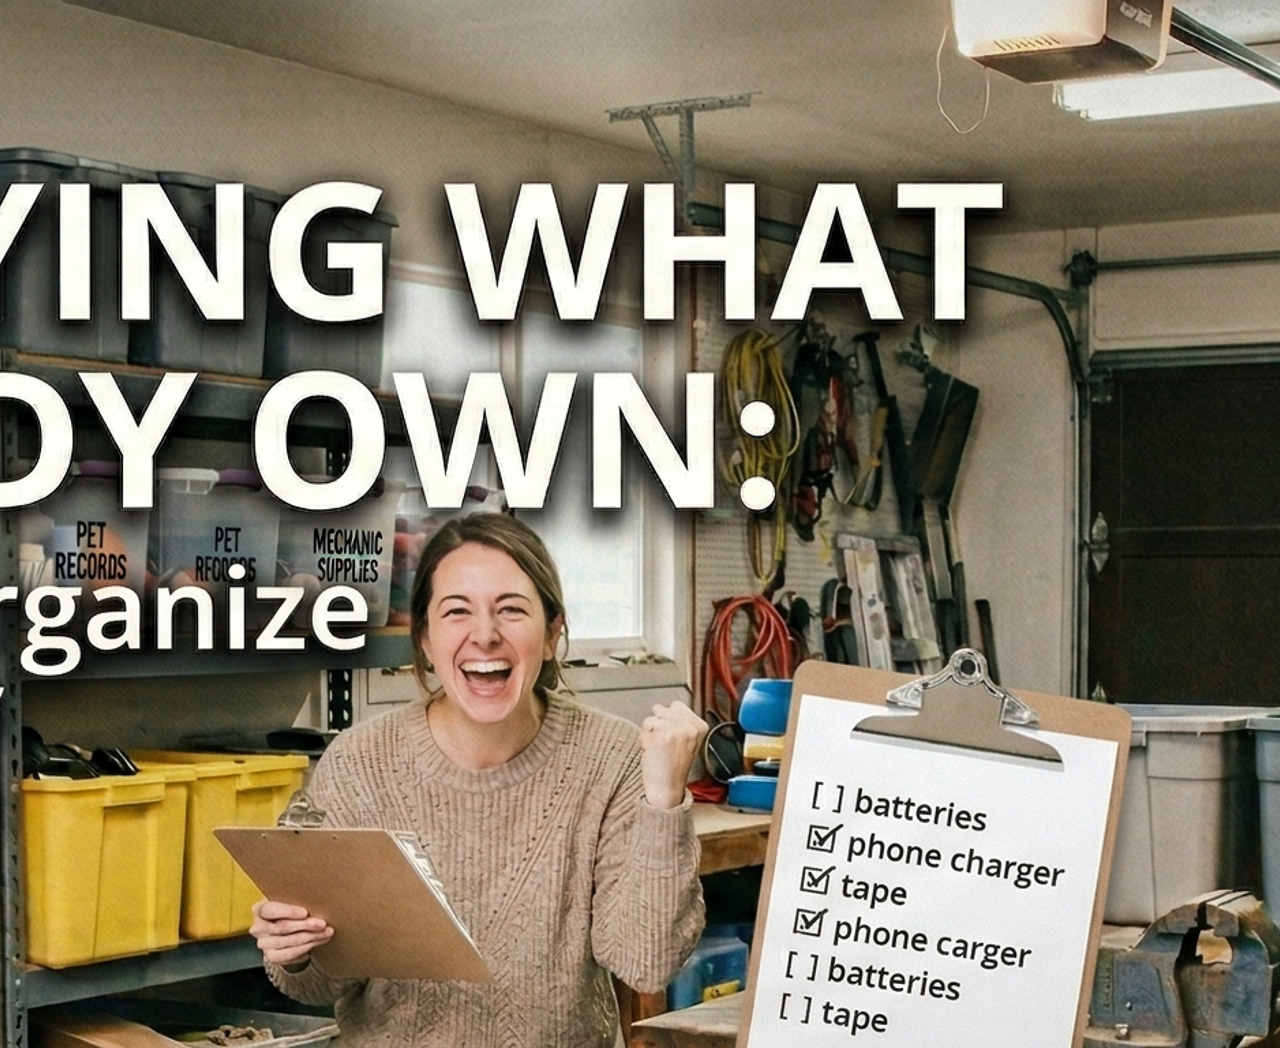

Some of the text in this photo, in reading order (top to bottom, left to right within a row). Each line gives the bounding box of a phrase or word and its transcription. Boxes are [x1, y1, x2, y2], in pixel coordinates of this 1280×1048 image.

[76, 520, 107, 548] PET
[215, 526, 241, 553] PET
[54, 551, 127, 581] RECORDS
[854, 788, 987, 831] batteries
[847, 832, 1065, 889] phone charger
[841, 874, 907, 909] tape
[833, 917, 1032, 970] phone carger
[828, 956, 961, 1001] batteries
[822, 1001, 888, 1036] tape
